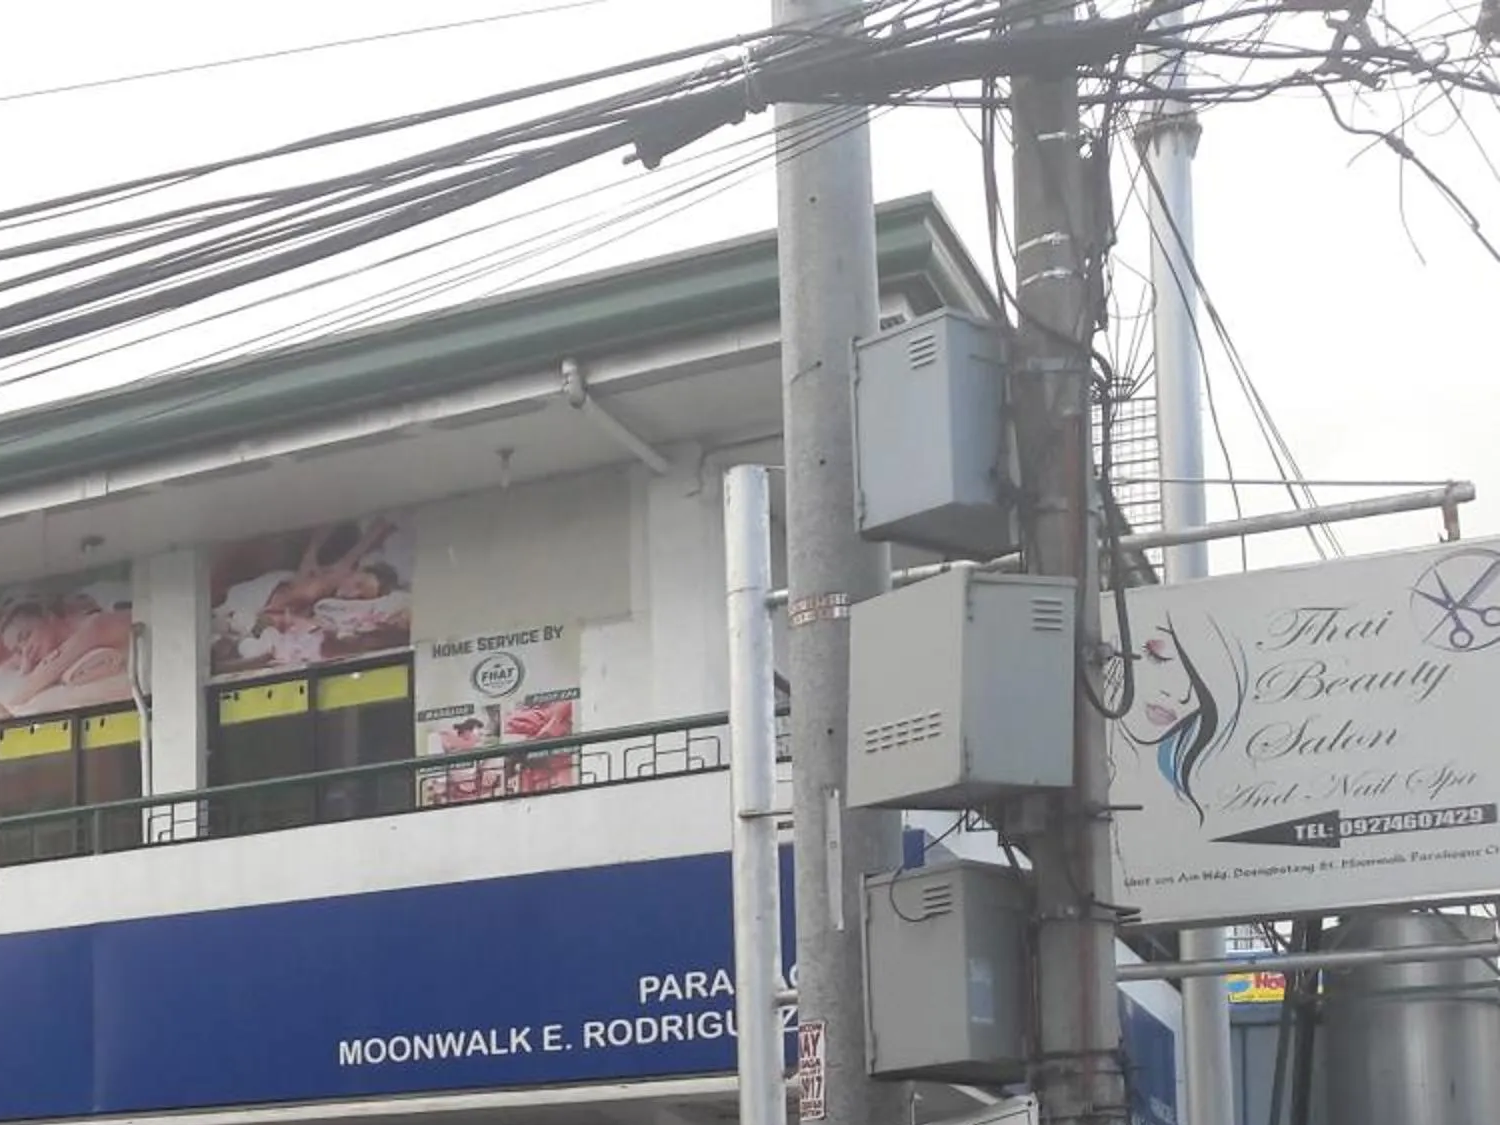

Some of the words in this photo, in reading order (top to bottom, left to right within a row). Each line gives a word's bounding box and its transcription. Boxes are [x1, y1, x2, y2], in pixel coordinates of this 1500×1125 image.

[432, 640, 472, 659] HOME
[477, 630, 540, 651] SERVICE
[543, 625, 564, 641] BY
[1256, 607, 1393, 651] Thai
[1252, 658, 1450, 704] Beauty
[1246, 715, 1397, 759] Salon
[1304, 768, 1398, 799] Nail
[1405, 758, 1477, 800] Spa
[1293, 822, 1334, 841] TEL:
[1339, 806, 1484, 838] 09274607429
[338, 1026, 532, 1066] MOONWALK
[543, 1024, 571, 1052] E.
